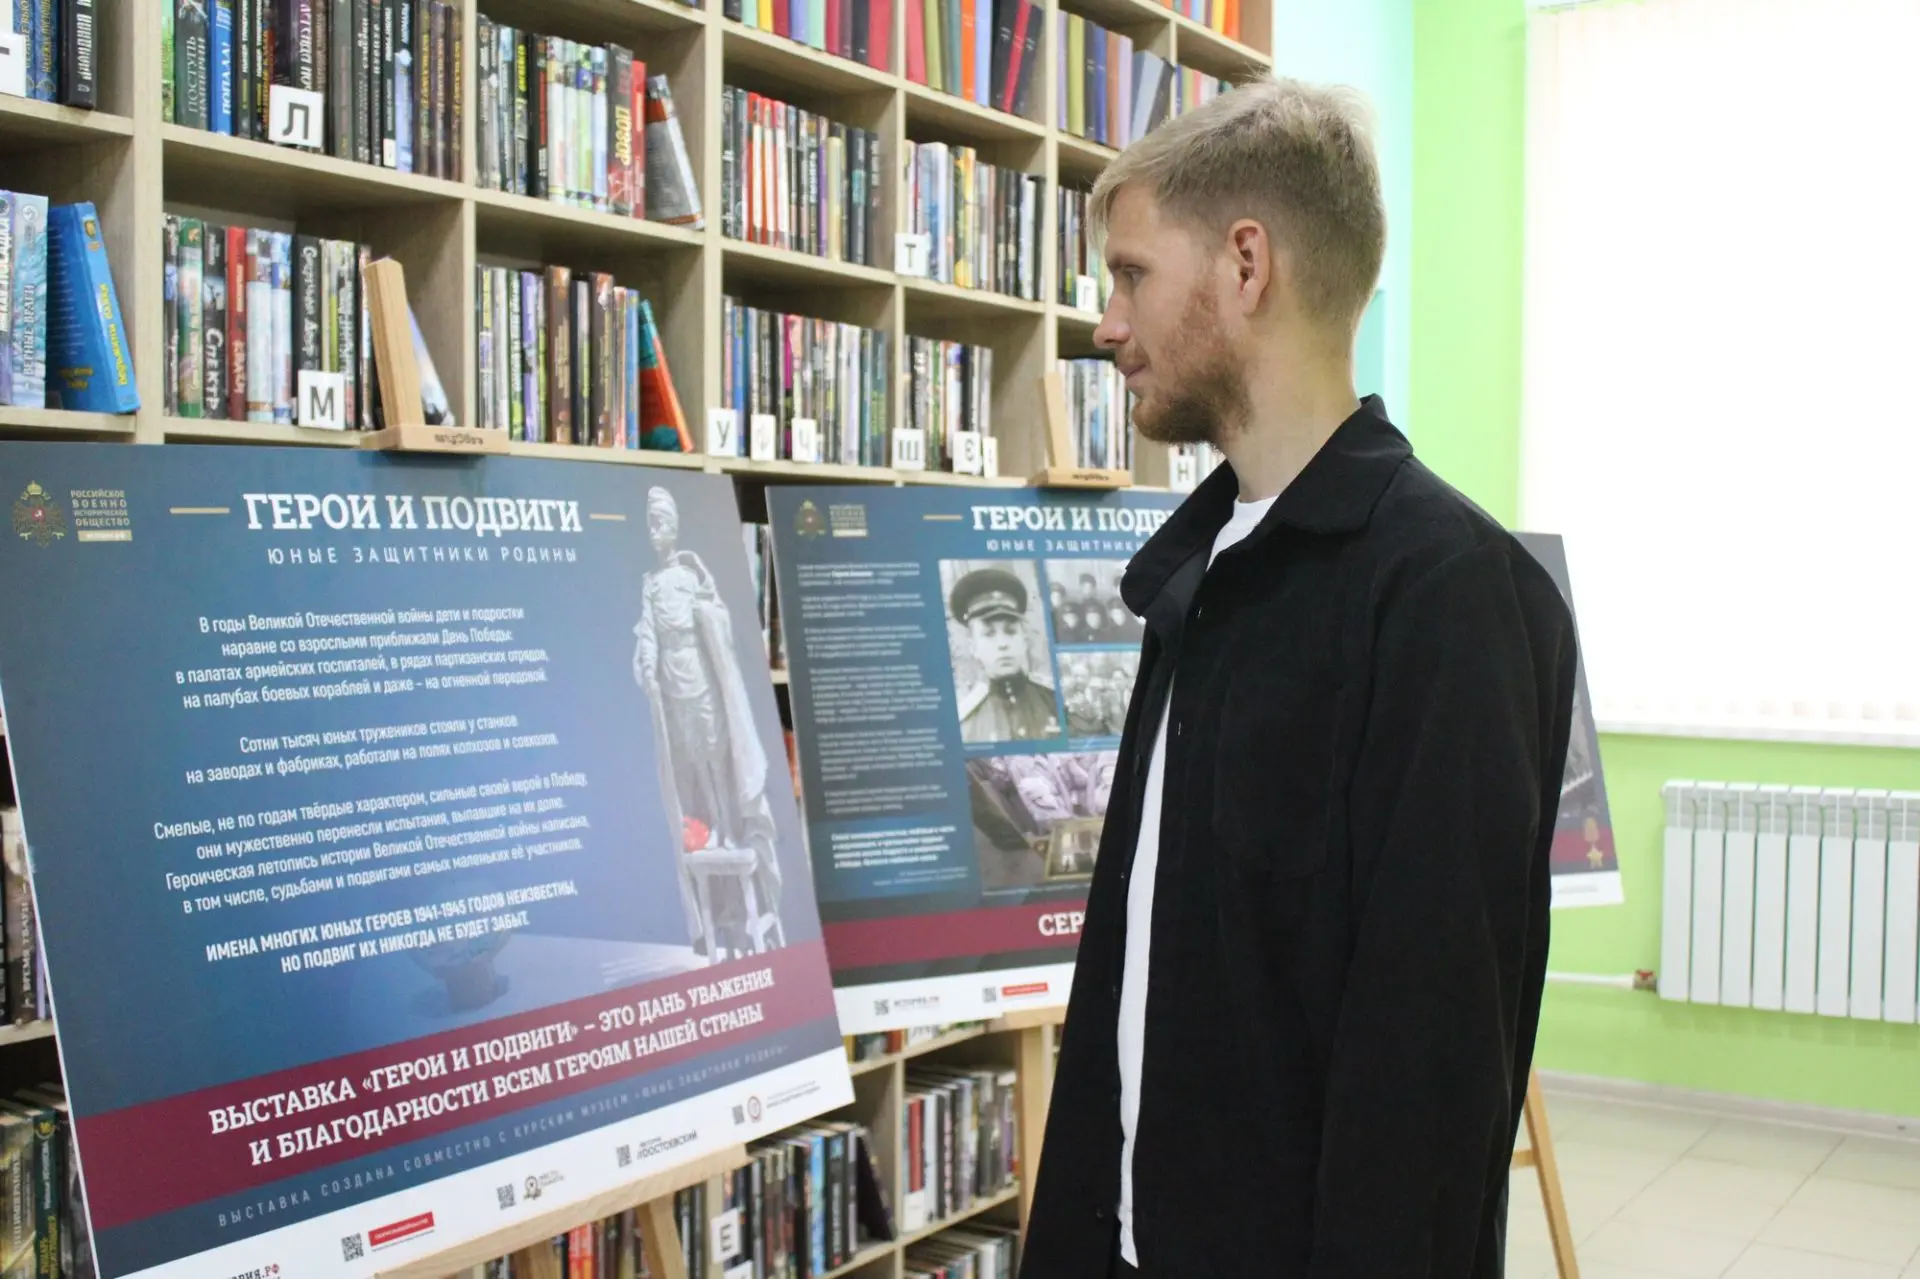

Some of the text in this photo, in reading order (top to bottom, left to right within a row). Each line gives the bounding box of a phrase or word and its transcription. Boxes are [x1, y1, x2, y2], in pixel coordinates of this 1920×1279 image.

[186, 36, 197, 113] ПОСТУПЬ
[283, 102, 309, 140] Л
[615, 104, 632, 166] ДОЗОР
[904, 243, 916, 268] Т
[23, 327, 35, 377] ВЕРНЫЕ
[310, 386, 334, 421] М
[717, 420, 730, 448] У
[899, 440, 919, 460] Ш
[70, 488, 125, 498] РОССИЙСКОЕ
[72, 499, 128, 508] ВОЕННО
[75, 518, 131, 528] ОБЩЕСТВО
[243, 493, 583, 538] ГЕРОИ И ПОДВИГИ
[971, 506, 1174, 537] ГЕРОИ И ПОДВ
[268, 546, 577, 566] ЮНЫЕ ЗАЩИТНИКИ РОДИНЫ
[986, 539, 1036, 552] ЮНЫЕ
[199, 607, 525, 634] В годы Великой Отечественной войны дети и подростки
[221, 640, 277, 659] наравне
[280, 641, 296, 654] со
[299, 634, 367, 654] взрослыми
[369, 630, 439, 650] приближали
[442, 628, 469, 646] День
[175, 670, 185, 684] в
[187, 667, 243, 684] палатах
[245, 660, 316, 682] армейских
[317, 654, 389, 674] госпиталей,
[390, 656, 398, 669] в
[400, 655, 433, 672] рядах
[435, 649, 506, 669] партизанских
[183, 695, 201, 709] на
[204, 688, 259, 709] палубах
[261, 684, 310, 702] боевых
[312, 678, 370, 700] кораблей
[373, 681, 381, 693] и
[384, 678, 414, 695] даже
[425, 677, 438, 689] на
[442, 670, 490, 689] огненной
[240, 714, 518, 754] Сотни тысяч юных тружеников стояли у станков
[186, 768, 204, 785] на
[207, 760, 263, 783] заводах
[266, 761, 274, 775] и
[276, 753, 342, 777] фабриках,
[345, 744, 400, 770] работали
[403, 744, 417, 760] на
[420, 741, 450, 758] полях
[452, 737, 502, 755] колхозов
[504, 736, 510, 748] и
[154, 818, 215, 840] Смелые,
[218, 815, 235, 832] не
[238, 812, 255, 829] по
[257, 809, 297, 829] годам
[300, 799, 352, 823] твёрдые
[356, 792, 429, 817] характером,
[430, 787, 476, 804] сильные
[479, 779, 510, 797] своей
[512, 776, 542, 794] верой
[544, 778, 550, 789] в
[196, 800, 536, 860] они мужественно перенесли испытания, выпавшие на их
[165, 864, 254, 892] Героическая
[258, 854, 318, 877] летопись
[321, 845, 372, 866] истории
[373, 836, 424, 858] Великой
[425, 826, 506, 851] Отечественной
[508, 819, 540, 838] войны
[184, 901, 193, 914] в
[196, 896, 222, 911] том
[224, 887, 269, 907] числе,
[271, 876, 333, 900] судьбами
[336, 879, 345, 892] и
[347, 860, 411, 885] подвигами
[414, 856, 450, 876] самых
[453, 849, 509, 870] маленьких
[511, 845, 524, 860] её
[205, 936, 258, 963] ИМЕНА
[260, 925, 318, 953] МНОГИХ
[320, 917, 364, 943] ЮНЫХ
[365, 910, 413, 934] ГЕРОЕВ
[414, 898, 467, 925] 1941-1945
[467, 893, 506, 915] ГОДОВ
[1038, 912, 1086, 936] СЕР
[281, 954, 302, 974] НО
[303, 943, 357, 972] ПОДВИГ
[359, 940, 378, 958] ИХ
[379, 929, 436, 957] НИКОГДА
[437, 926, 454, 943] НЕ
[455, 917, 489, 941] БУДЕТ
[208, 968, 775, 1135] ВЫСТАВКА «ГЕРОИ И ПОДВИГИ» ЭТО ДАНЬ УВАЖЕНИЯ
[248, 1003, 764, 1166] И БЛАГОДАРНОСТИ ВСЕМ ГЕРОЯМ НАШЕЙ СТРАНЫ
[218, 1188, 311, 1227] ВЫСТАВКА
[321, 1166, 396, 1199] СОЗДАНА
[403, 1136, 492, 1173] СОВМЕСТНО
[498, 1130, 508, 1142] С
[580, 1093, 628, 1119] МУЗЕЕМ
[720, 1223, 732, 1252] Е
